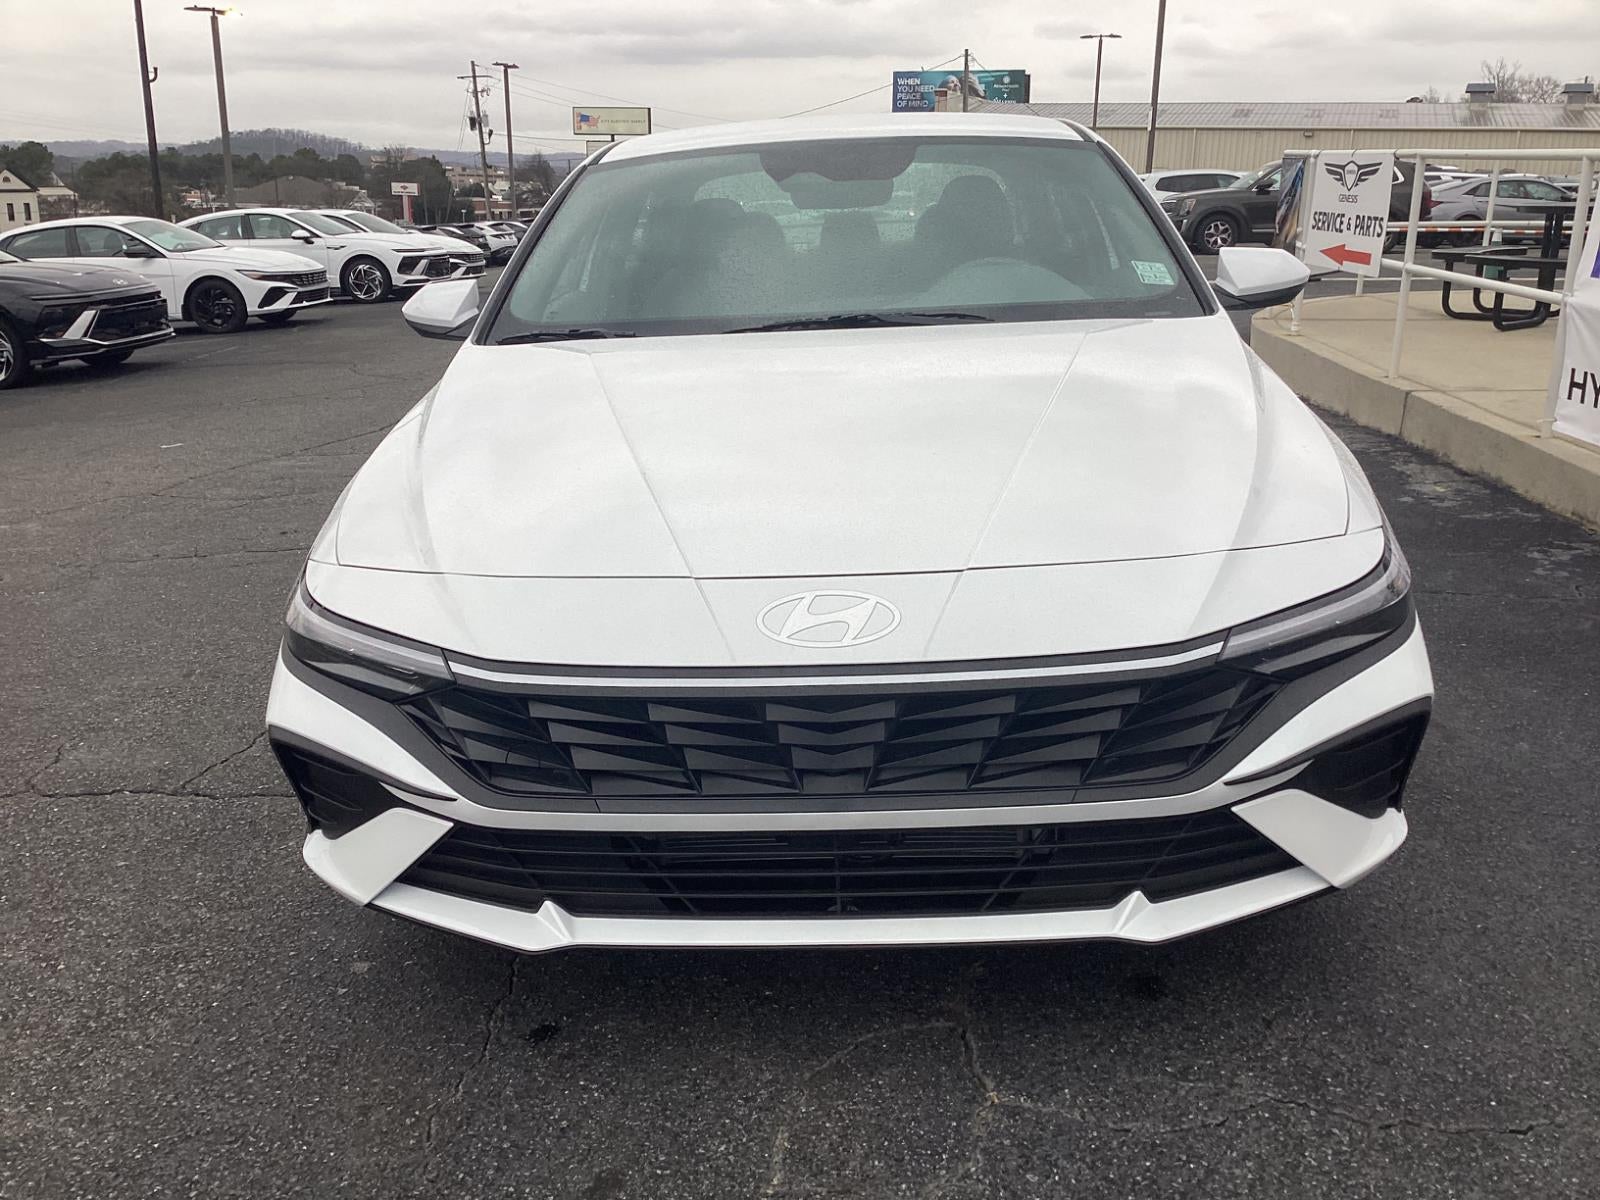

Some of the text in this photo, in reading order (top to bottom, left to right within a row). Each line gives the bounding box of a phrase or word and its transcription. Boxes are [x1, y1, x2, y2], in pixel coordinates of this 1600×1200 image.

[1338, 193, 1359, 204] GENESIS
[1312, 211, 1384, 238] SERVICE & PARTS
